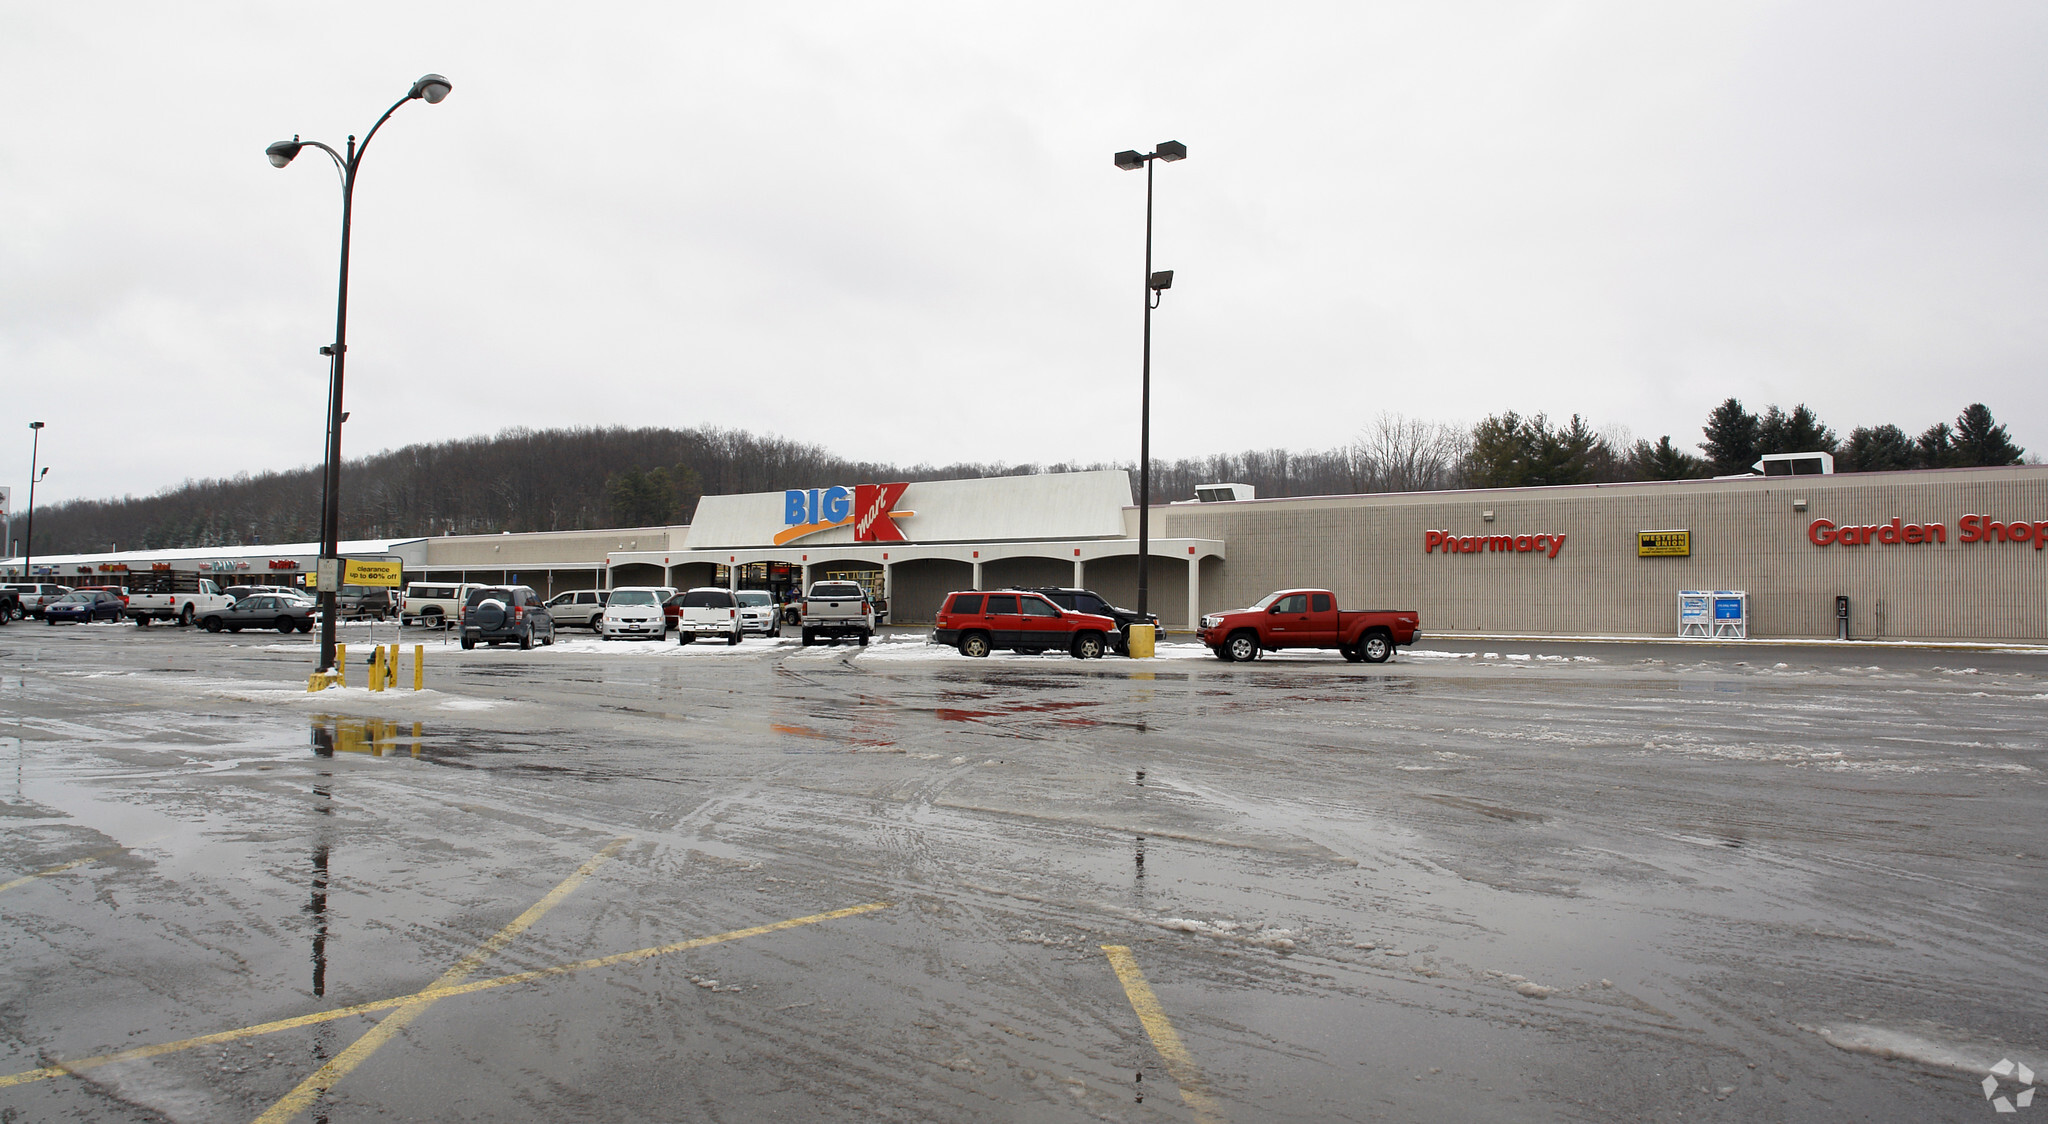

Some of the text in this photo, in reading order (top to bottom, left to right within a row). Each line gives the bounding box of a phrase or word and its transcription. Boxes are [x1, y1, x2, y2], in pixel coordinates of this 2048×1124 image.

[785, 482, 910, 542] BIG K
[857, 487, 887, 538] mart
[1809, 517, 1946, 546] Garden
[1425, 529, 1566, 558] Pharmacy
